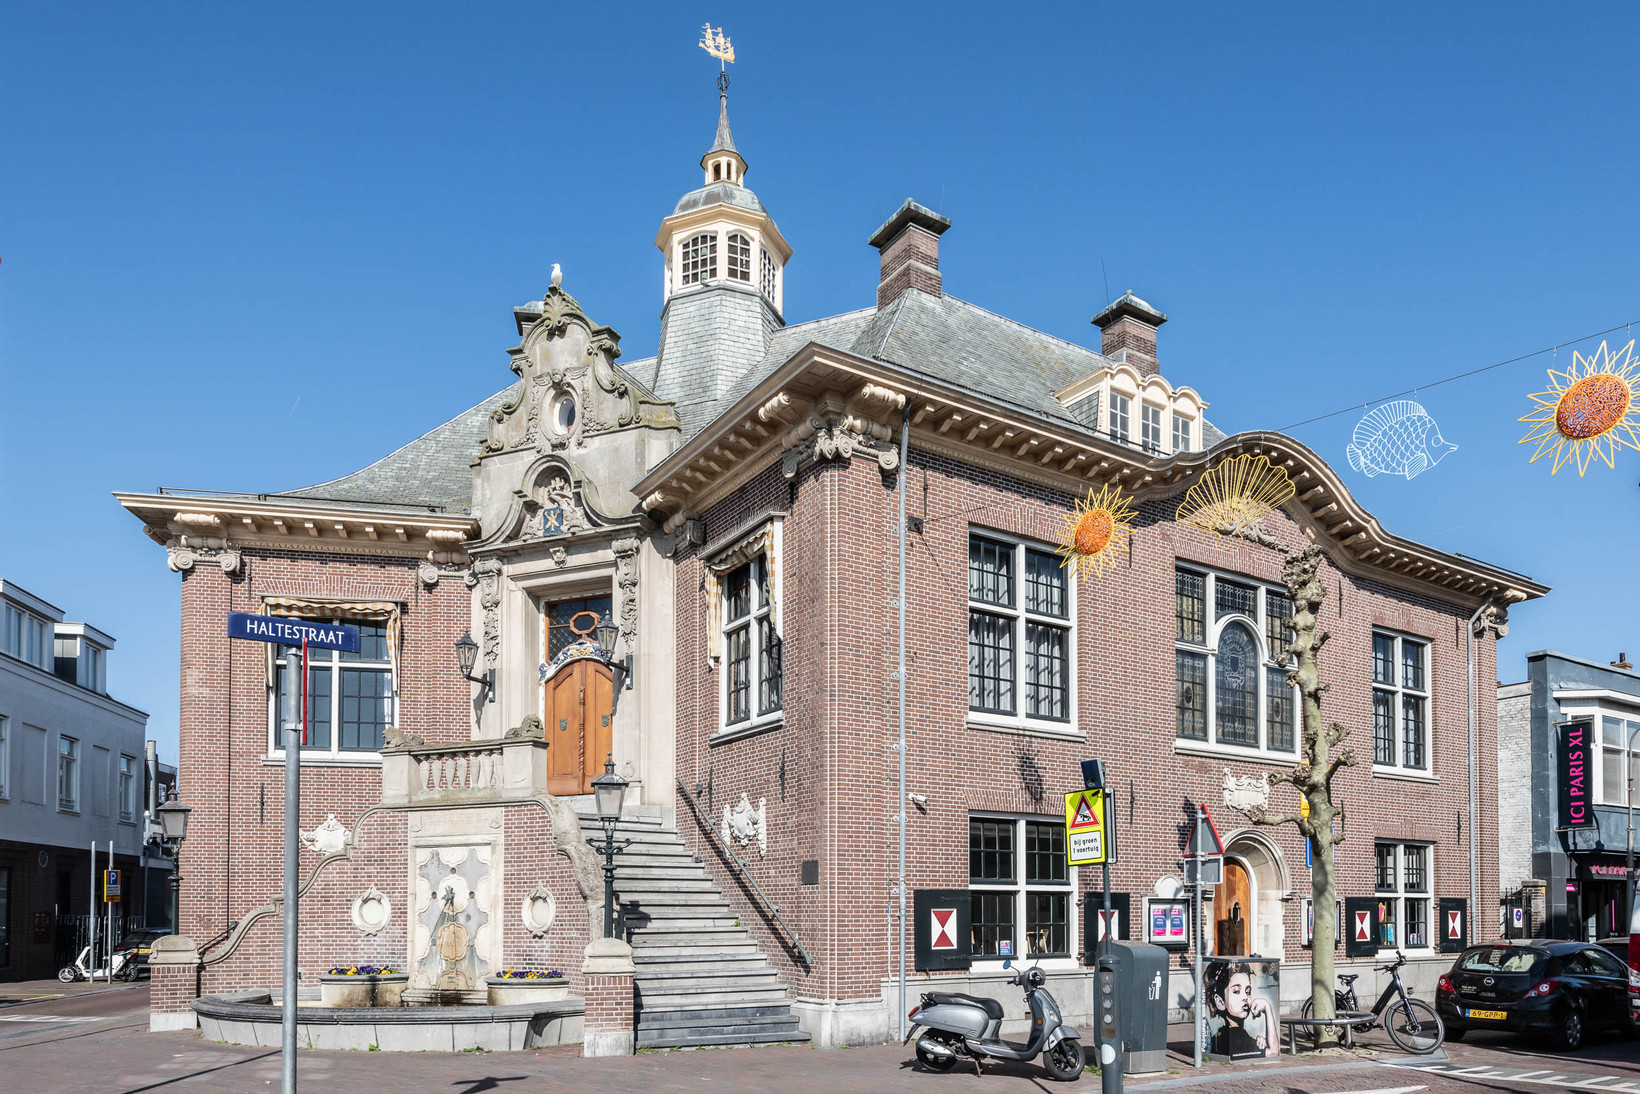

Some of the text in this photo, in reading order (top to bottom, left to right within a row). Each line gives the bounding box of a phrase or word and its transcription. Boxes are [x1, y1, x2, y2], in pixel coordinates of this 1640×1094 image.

[246, 619, 345, 644] HALTESTRAAT
[1568, 727, 1585, 823] ICI PARIS XL
